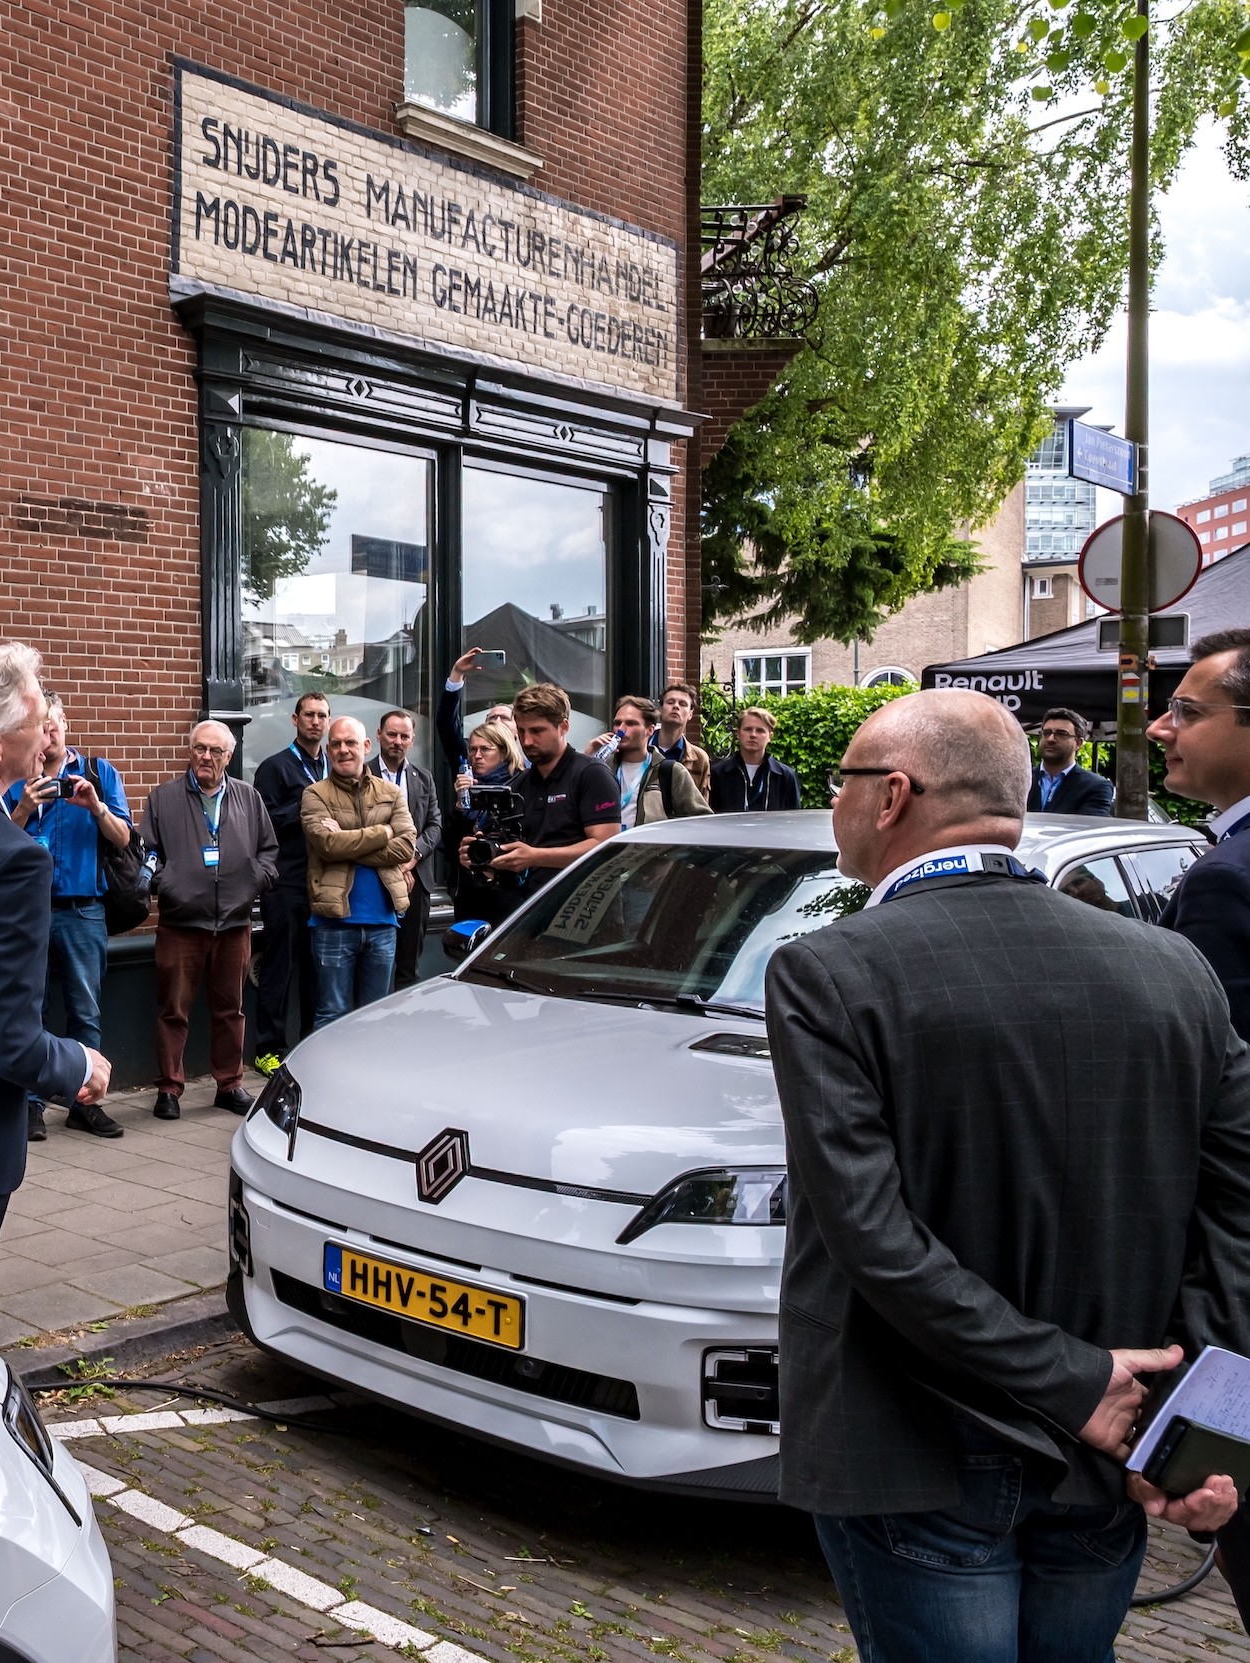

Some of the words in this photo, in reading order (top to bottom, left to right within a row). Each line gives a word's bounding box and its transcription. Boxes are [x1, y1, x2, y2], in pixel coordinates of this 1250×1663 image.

[195, 191, 417, 300] MODEARTIKELEN
[366, 173, 667, 312] MANUFACTURENHANDEL
[935, 670, 1043, 692] Renault
[894, 858, 968, 891] nergized
[328, 1271, 340, 1285] NL
[350, 1258, 508, 1336] HHV-54-T
